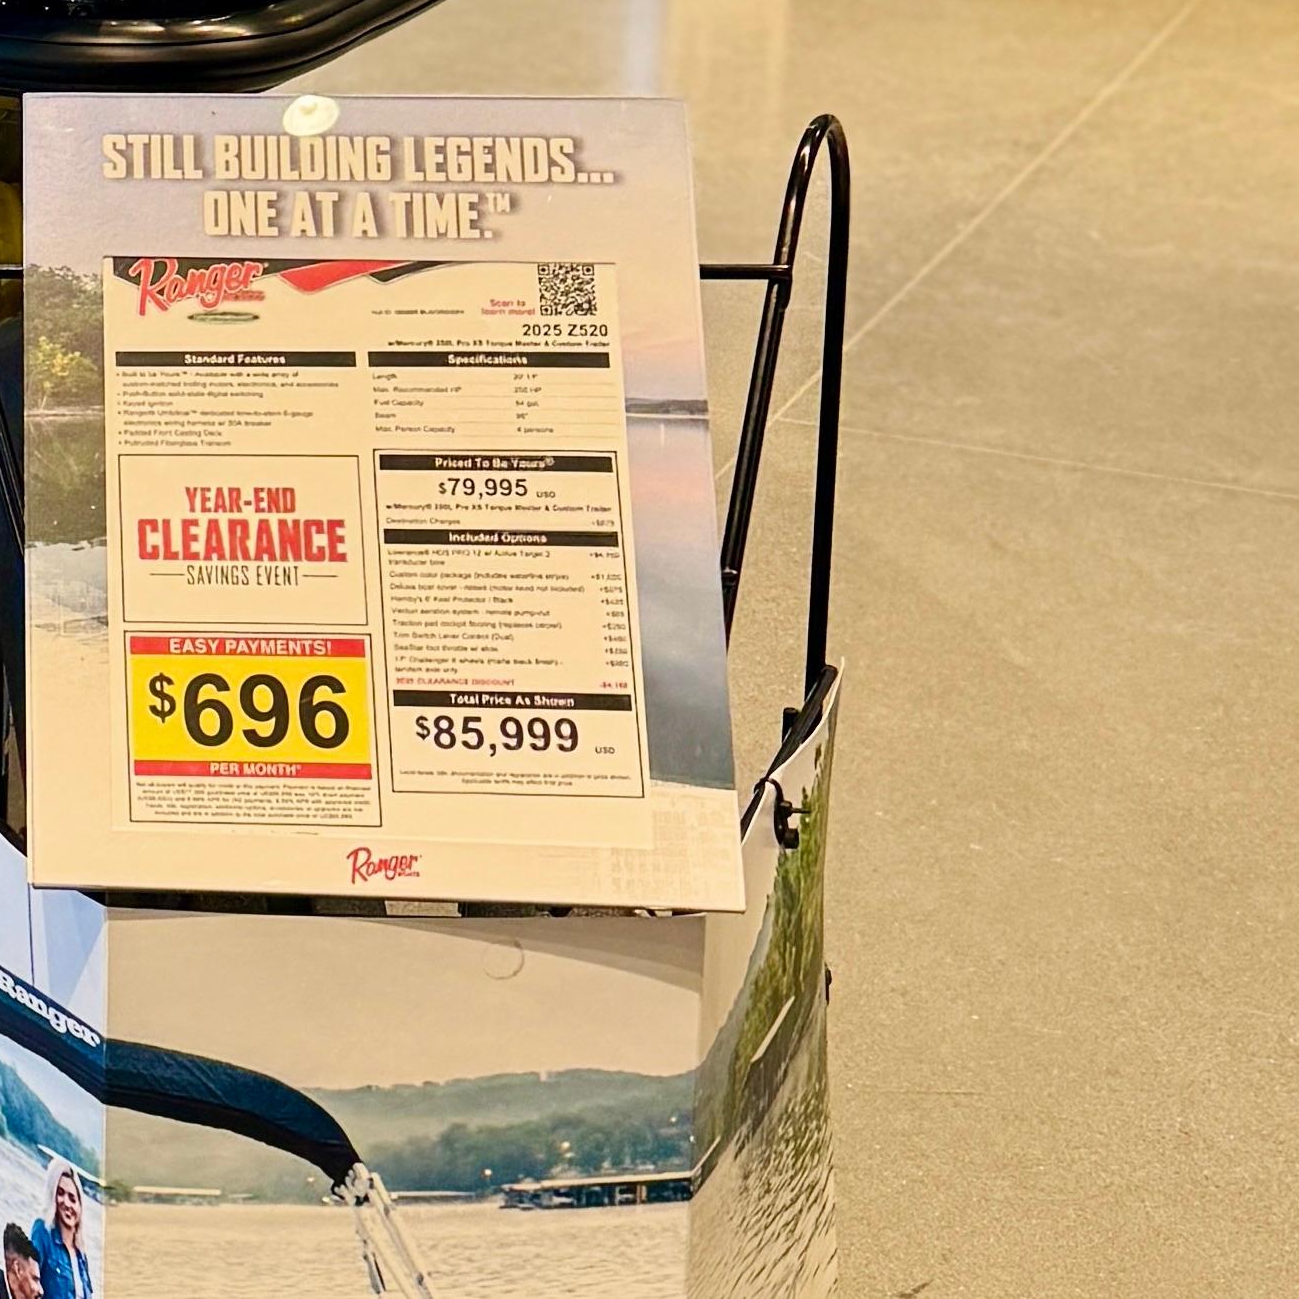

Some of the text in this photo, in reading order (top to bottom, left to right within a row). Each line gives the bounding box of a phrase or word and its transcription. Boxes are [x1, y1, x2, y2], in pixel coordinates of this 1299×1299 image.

[102, 133, 615, 184] STILL BUILDING LEGENDS...
[204, 190, 279, 238] ONE
[289, 192, 340, 239] AT
[350, 192, 379, 239] A
[129, 257, 264, 317] Ranger
[522, 323, 609, 338] 2025 Z520
[184, 353, 286, 365] Standard Features
[447, 353, 528, 366] Specifications
[434, 456, 472, 468] Priced
[474, 457, 490, 468] To
[438, 477, 528, 500] $79,995
[184, 486, 296, 514] YEAR-END
[137, 518, 348, 563] CLEARANCE
[448, 532, 548, 544] Included Options
[186, 564, 300, 586] SAVINGS EVENT
[169, 637, 332, 654] EASY PAYMENTS!
[148, 671, 350, 749] $696
[449, 692, 575, 707] Total Price As Shown
[415, 714, 616, 758] $85,999 USD
[209, 762, 240, 775] PER
[346, 846, 419, 885] Ranger
